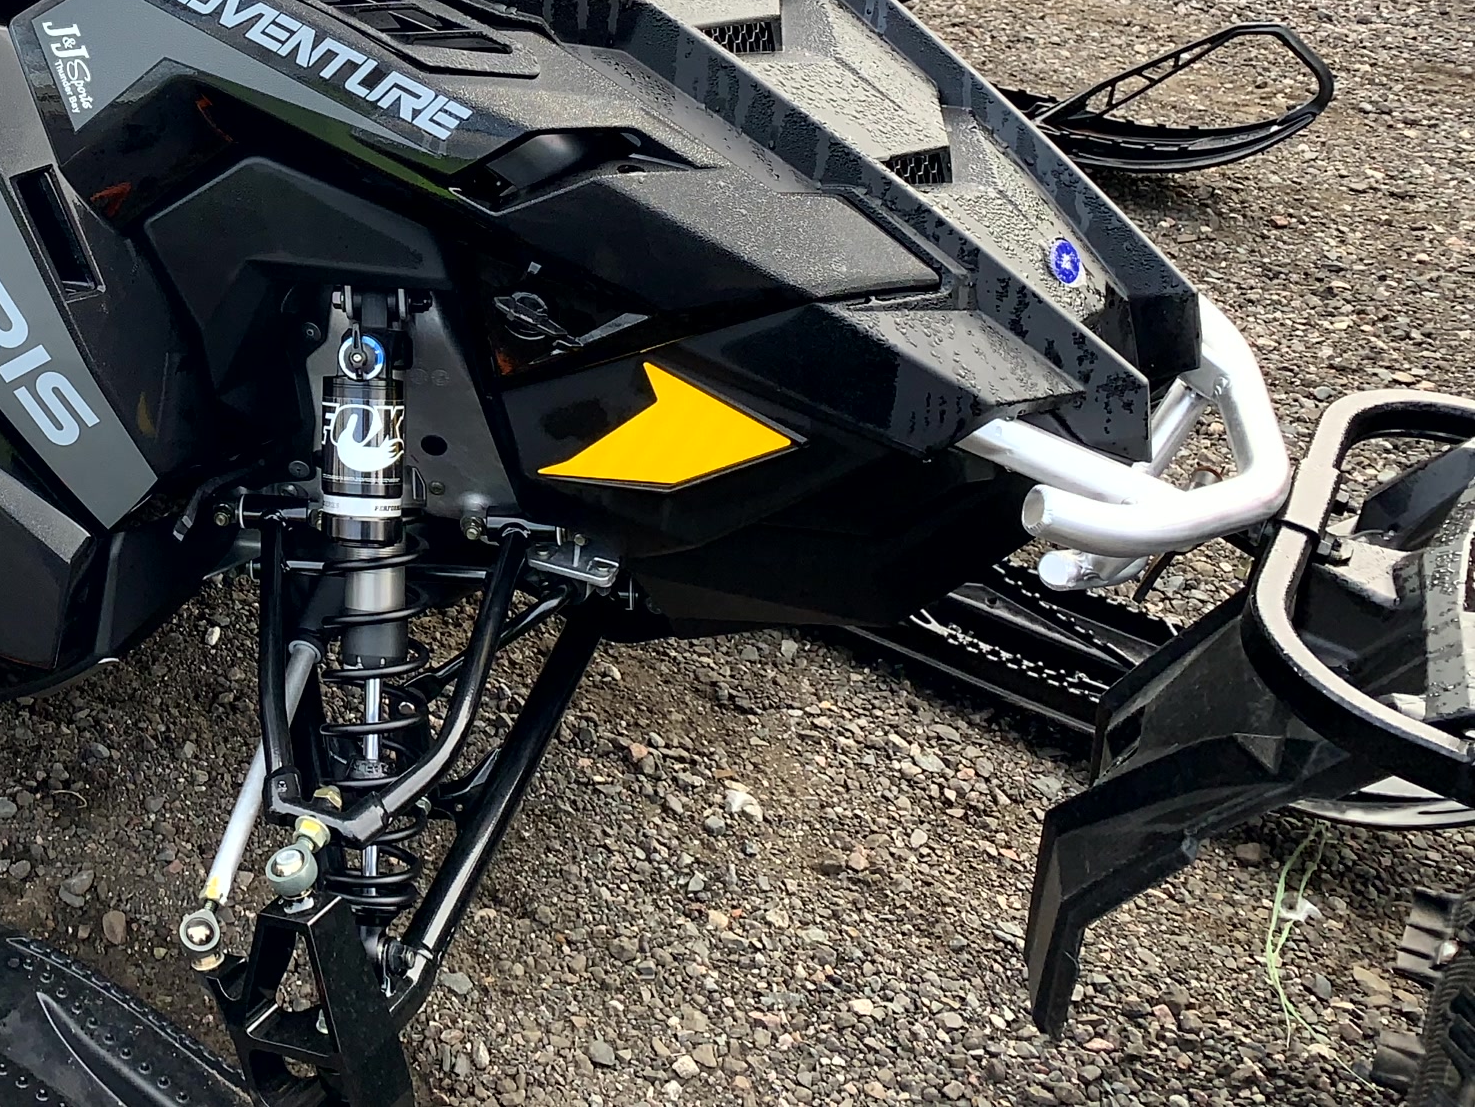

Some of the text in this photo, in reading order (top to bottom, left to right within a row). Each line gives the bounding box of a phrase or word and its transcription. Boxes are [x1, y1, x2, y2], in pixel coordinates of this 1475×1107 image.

[42, 21, 89, 59] J&J
[66, 58, 93, 109] Sports
[54, 58, 80, 113] Thunder Bay
[322, 401, 404, 447] FOX
